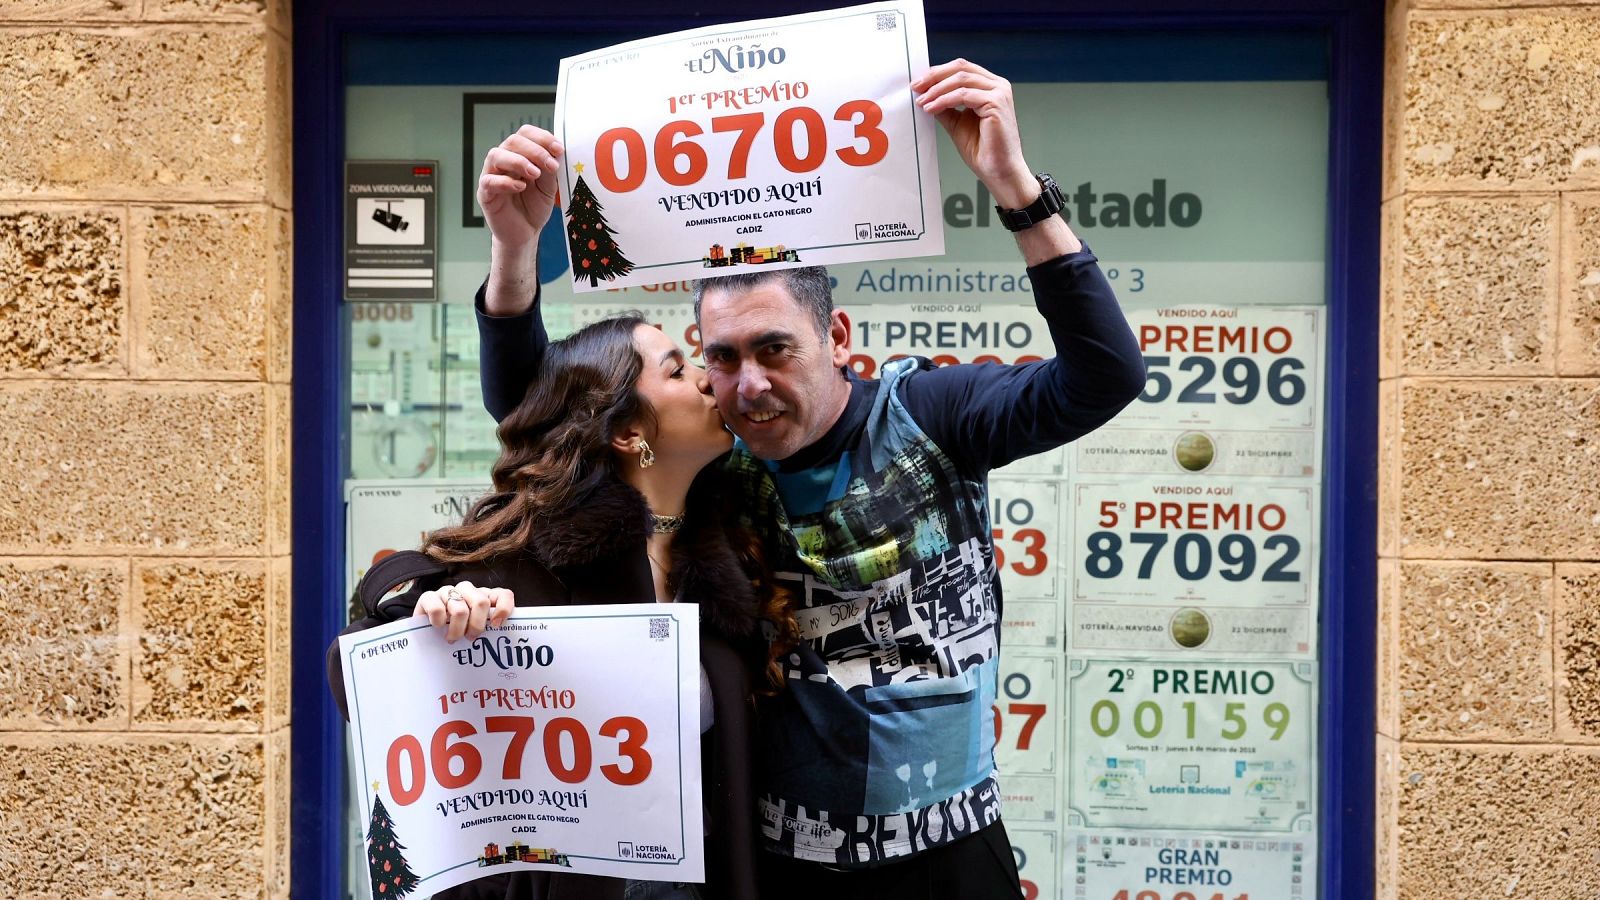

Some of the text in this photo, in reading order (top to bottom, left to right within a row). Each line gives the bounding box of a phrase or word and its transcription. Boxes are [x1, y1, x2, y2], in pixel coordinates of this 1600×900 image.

[684, 42, 786, 74] El Niño
[667, 80, 809, 114] 1er PREMIO
[594, 99, 889, 194] 06703
[349, 184, 433, 193] ZONA VIDEOVIGILADA
[658, 176, 822, 213] VENDIDO AQUÍ
[1062, 179, 1203, 228] tado
[685, 206, 813, 228] ADMINISTRACION EL GATO NEGRO
[873, 221, 908, 232] LOTERÍA
[736, 224, 763, 235] CADIZ
[874, 228, 917, 239] NACIONAL
[856, 267, 1032, 293] Administrac
[1129, 268, 1145, 292] 3
[910, 303, 982, 313] VENDIDO AQUÍ
[1157, 307, 1238, 318] VENDIDO AQUÍ
[885, 321, 1032, 348] PREMIO
[1140, 325, 1292, 354] PREMIO
[1137, 355, 1306, 406] 5296
[1085, 446, 1119, 455] LOTERÍA
[1153, 485, 1234, 496] VENDIDO AQUÍ
[1098, 501, 1286, 532] 5º PREMIO
[1085, 531, 1301, 583] 87092
[829, 600, 860, 627] SONG
[485, 623, 548, 633] Exaordinario de
[1081, 622, 1115, 631] LOTERÍA
[361, 638, 409, 660] 6 DE ENERO
[453, 636, 554, 670] El Niño
[1108, 668, 1274, 695] 2º PREMIO
[438, 686, 576, 714] 1er PREMIO
[1090, 699, 1291, 741] 00159
[1126, 744, 1149, 752] Sorteo
[386, 716, 653, 806] 06703
[1187, 786, 1231, 795] Nacional
[436, 788, 588, 818] VENDIDO AQUÍ
[461, 814, 580, 829] ADMINISTRACION EL GATO NEGRO
[512, 825, 537, 833] CADIZ
[810, 823, 832, 841] life
[635, 843, 668, 853] LOTERÍA
[636, 851, 677, 860] NACIONAL
[1158, 849, 1219, 866] GRAN
[1145, 867, 1233, 886] PREMIO
